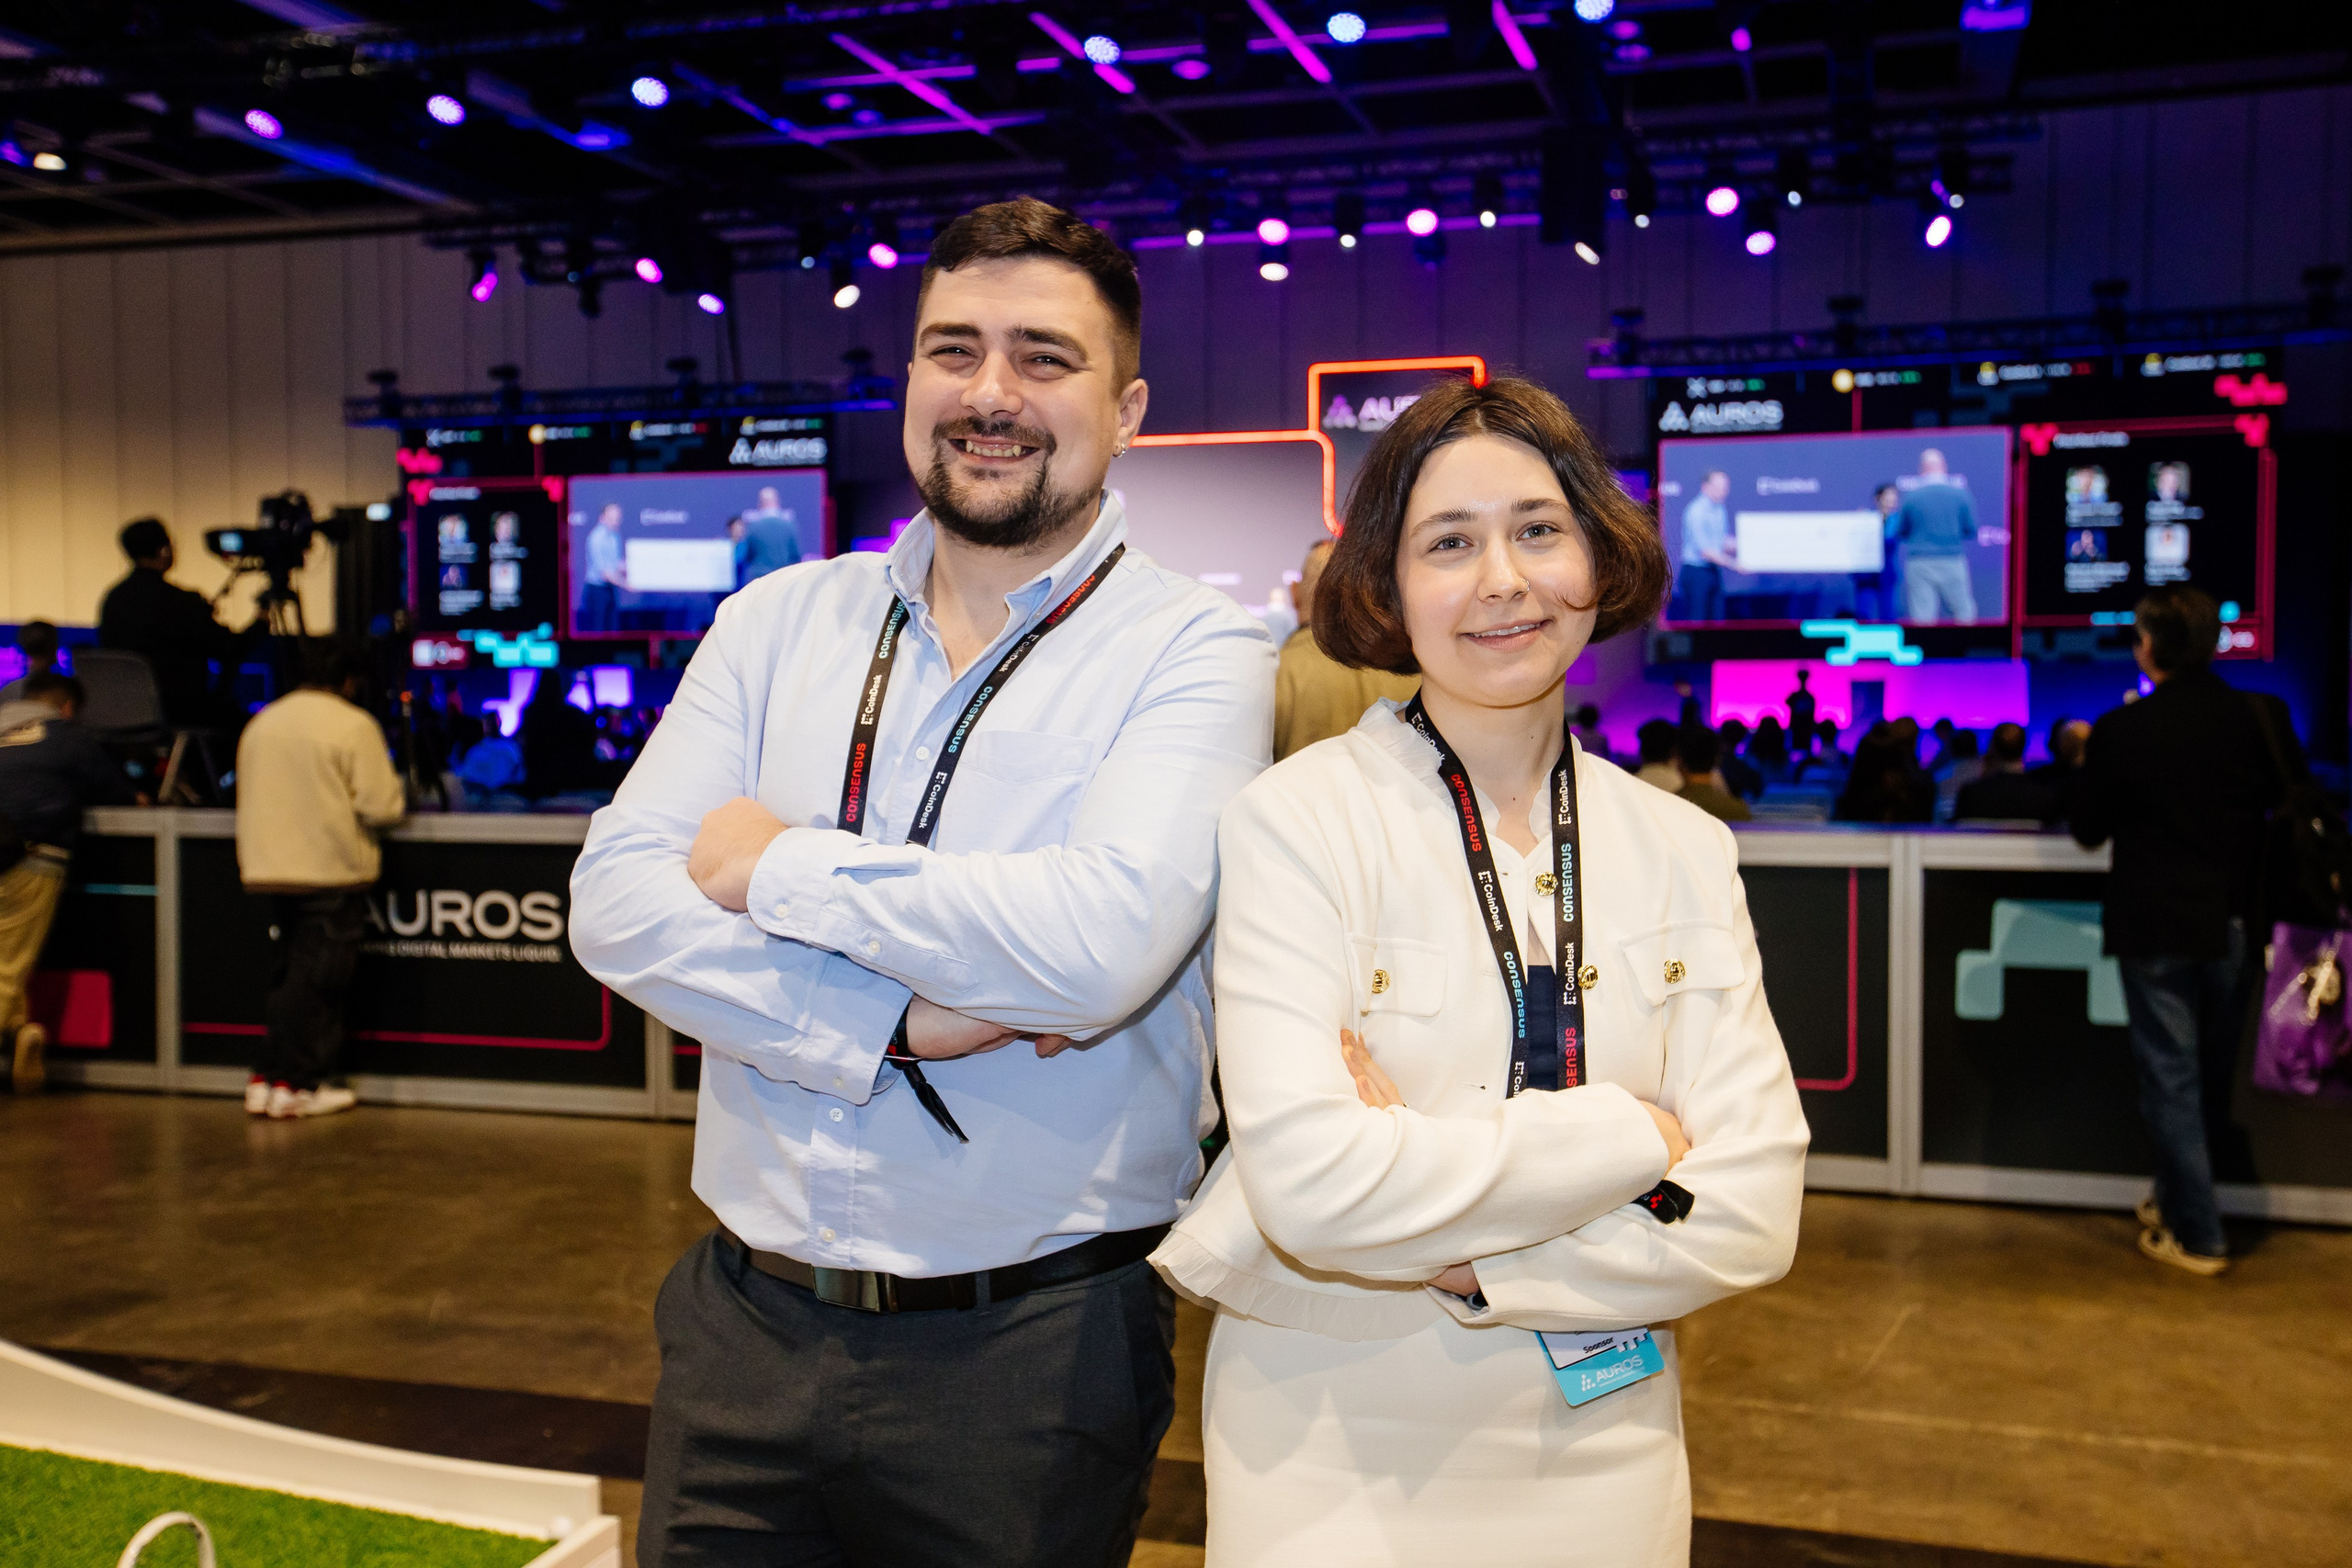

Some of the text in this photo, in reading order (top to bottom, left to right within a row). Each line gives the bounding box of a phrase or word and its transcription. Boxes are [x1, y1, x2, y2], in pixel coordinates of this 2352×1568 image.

[999, 641, 1030, 672] CoinDesk
[947, 685, 993, 753] CONSENSUS
[845, 742, 866, 822] CONSENSUS
[865, 674, 882, 714] CoinDesk
[919, 784, 941, 829] CoinDesk
[1559, 769, 1570, 814] CoinDesk
[1561, 842, 1574, 922] CONSENSUS
[1451, 773, 1482, 852] CONSENSUS
[1484, 884, 1504, 932] CoinDesk
[1503, 951, 1526, 1039] CONSENSUS
[1565, 942, 1575, 991] CoinDesk
[1583, 1337, 1614, 1354] Sponsor
[1596, 1355, 1643, 1382] AUROS
